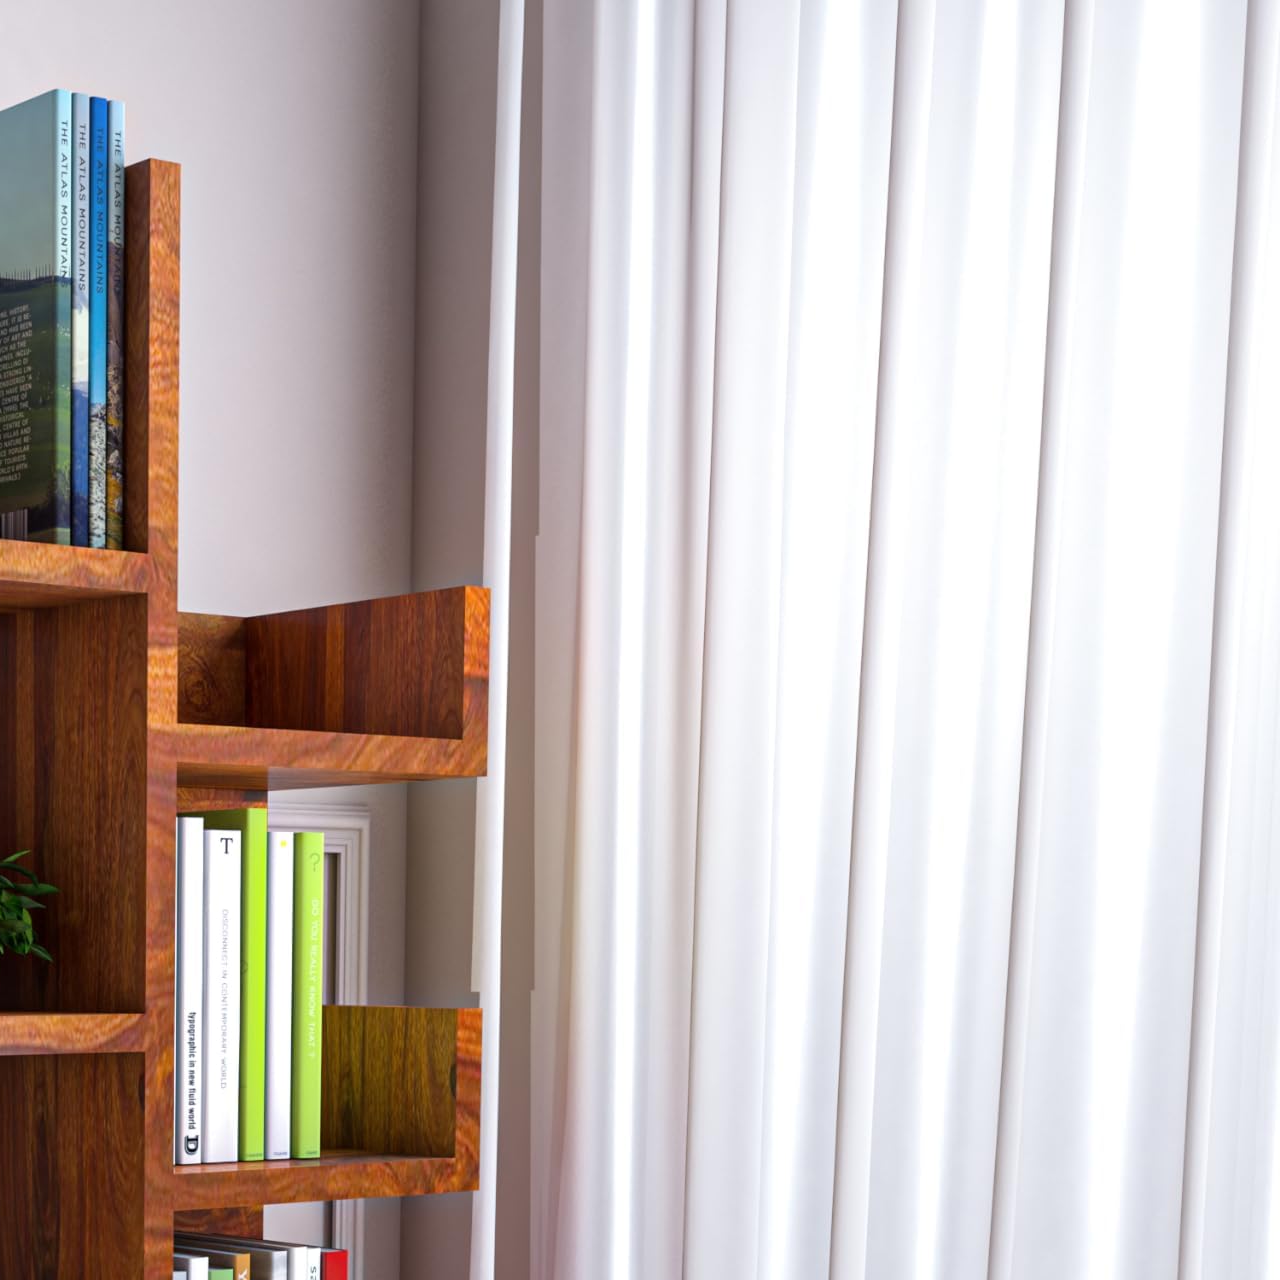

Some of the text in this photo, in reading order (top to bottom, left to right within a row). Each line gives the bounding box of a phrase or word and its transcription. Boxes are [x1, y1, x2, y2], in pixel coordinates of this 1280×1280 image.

[113, 132, 123, 157] THE
[113, 163, 123, 208] ATLAS
[60, 120, 69, 288] THE ATLAS MOUNTAINS
[78, 124, 87, 291] THE ATLAS MOUNTAINS
[95, 128, 104, 294] THE ATLAS MOUNTAINS
[220, 837, 233, 854] T
[311, 899, 319, 915] DO
[221, 909, 229, 967] DISCONNECT
[310, 921, 319, 940] YOU
[309, 945, 318, 983] REALLY
[308, 987, 317, 1017] KNOW
[187, 1012, 197, 1058] typographic
[188, 1060, 197, 1068] in
[220, 1056, 228, 1089] WORLD
[188, 1088, 197, 1106] fluid
[188, 1109, 197, 1130] world
[184, 1135, 199, 1156] D
